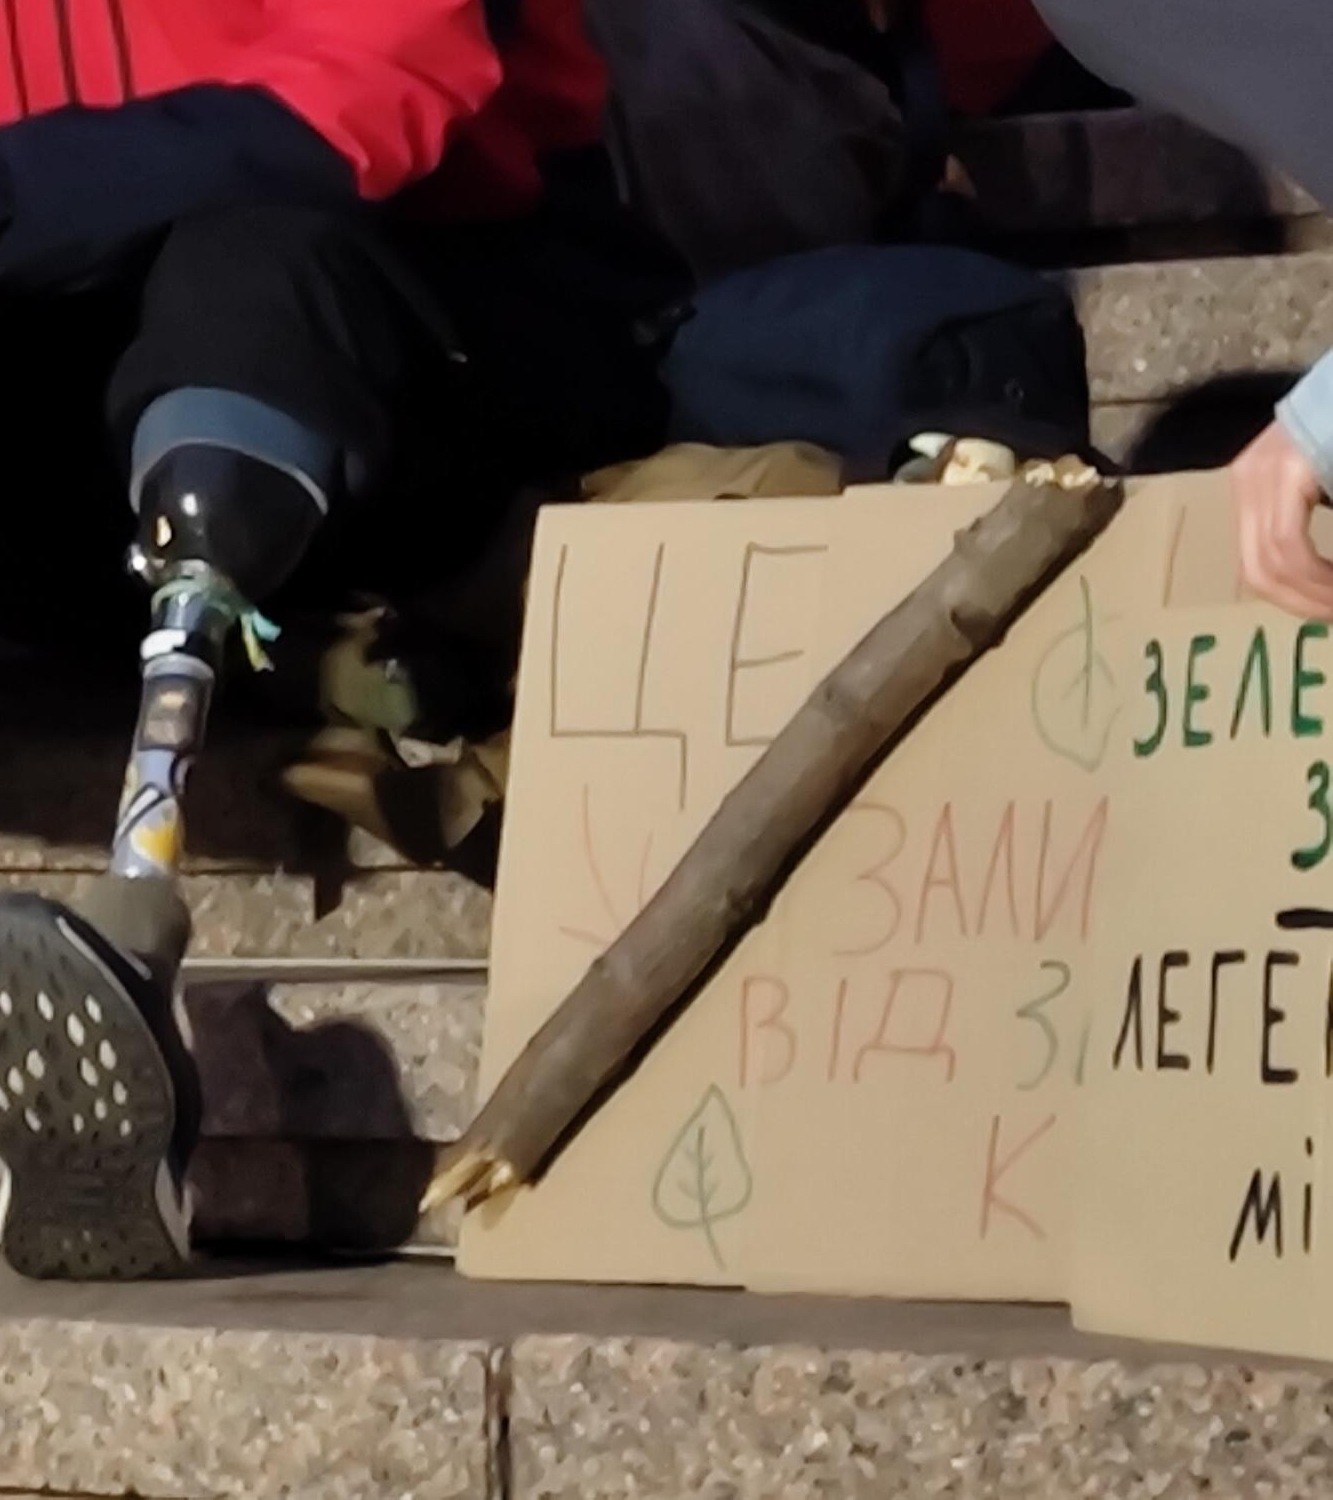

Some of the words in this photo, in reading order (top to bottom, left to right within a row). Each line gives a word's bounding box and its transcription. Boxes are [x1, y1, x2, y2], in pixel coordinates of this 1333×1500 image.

[550, 540, 829, 814] ЦЕ
[738, 968, 958, 1090] ВІД
[1112, 949, 1333, 1086] ЛЕГЕ
